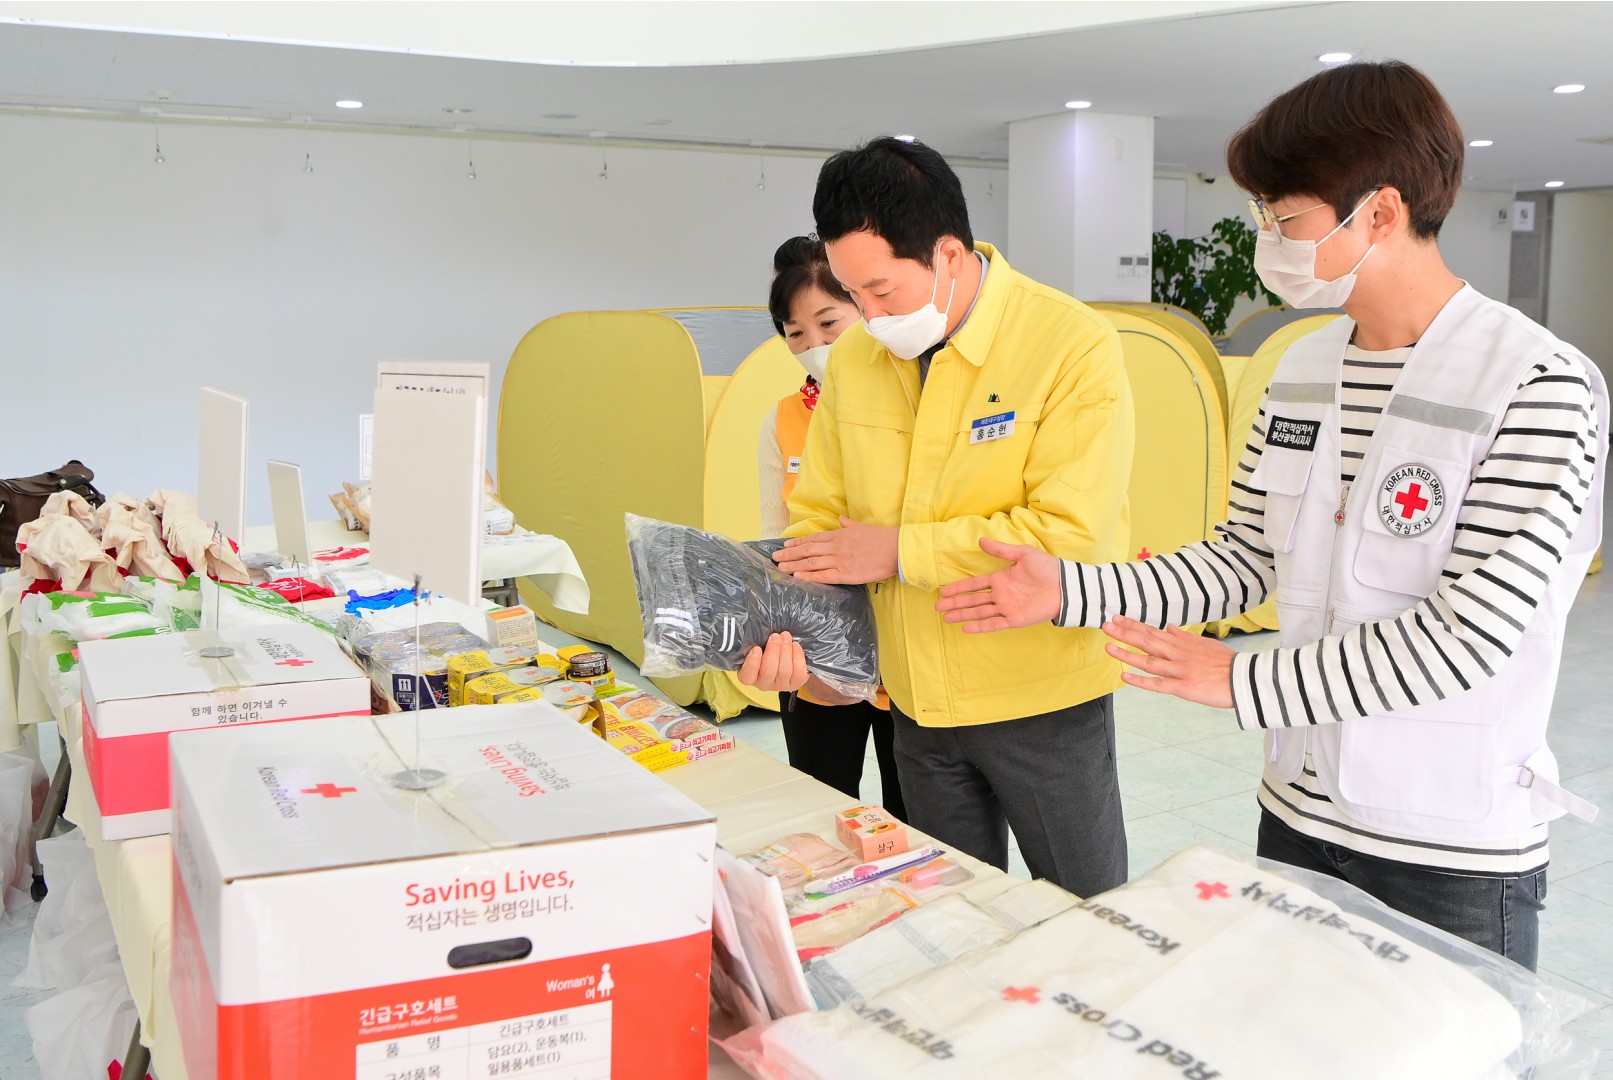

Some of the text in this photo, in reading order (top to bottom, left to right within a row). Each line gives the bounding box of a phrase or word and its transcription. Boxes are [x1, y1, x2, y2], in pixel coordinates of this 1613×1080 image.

[1271, 430, 1312, 446] 부산광역시지사
[1274, 420, 1314, 436] 대한적십자사
[1384, 467, 1443, 506] KOREAN RED CROSS
[1381, 505, 1433, 535] 대한적십자사
[190, 697, 288, 717] 함께 하면 이겨낼 수
[217, 711, 263, 725] 있습니다.
[501, 767, 547, 797] Saving
[877, 840, 896, 854] 살구
[404, 869, 575, 907] Saving Lives,
[406, 893, 574, 933] 적십자는 생명입니다.
[1077, 899, 1182, 956] Korean
[545, 975, 596, 993] Woman's
[584, 987, 596, 1000] 여
[358, 994, 459, 1027] 긴급구호세트
[499, 1013, 571, 1038] 긴급구호세트
[1051, 992, 1222, 1080] Red Cross
[487, 1030, 588, 1060] 담요(2), 운동복(1),
[487, 1051, 561, 1077] 일용품세트(1)
